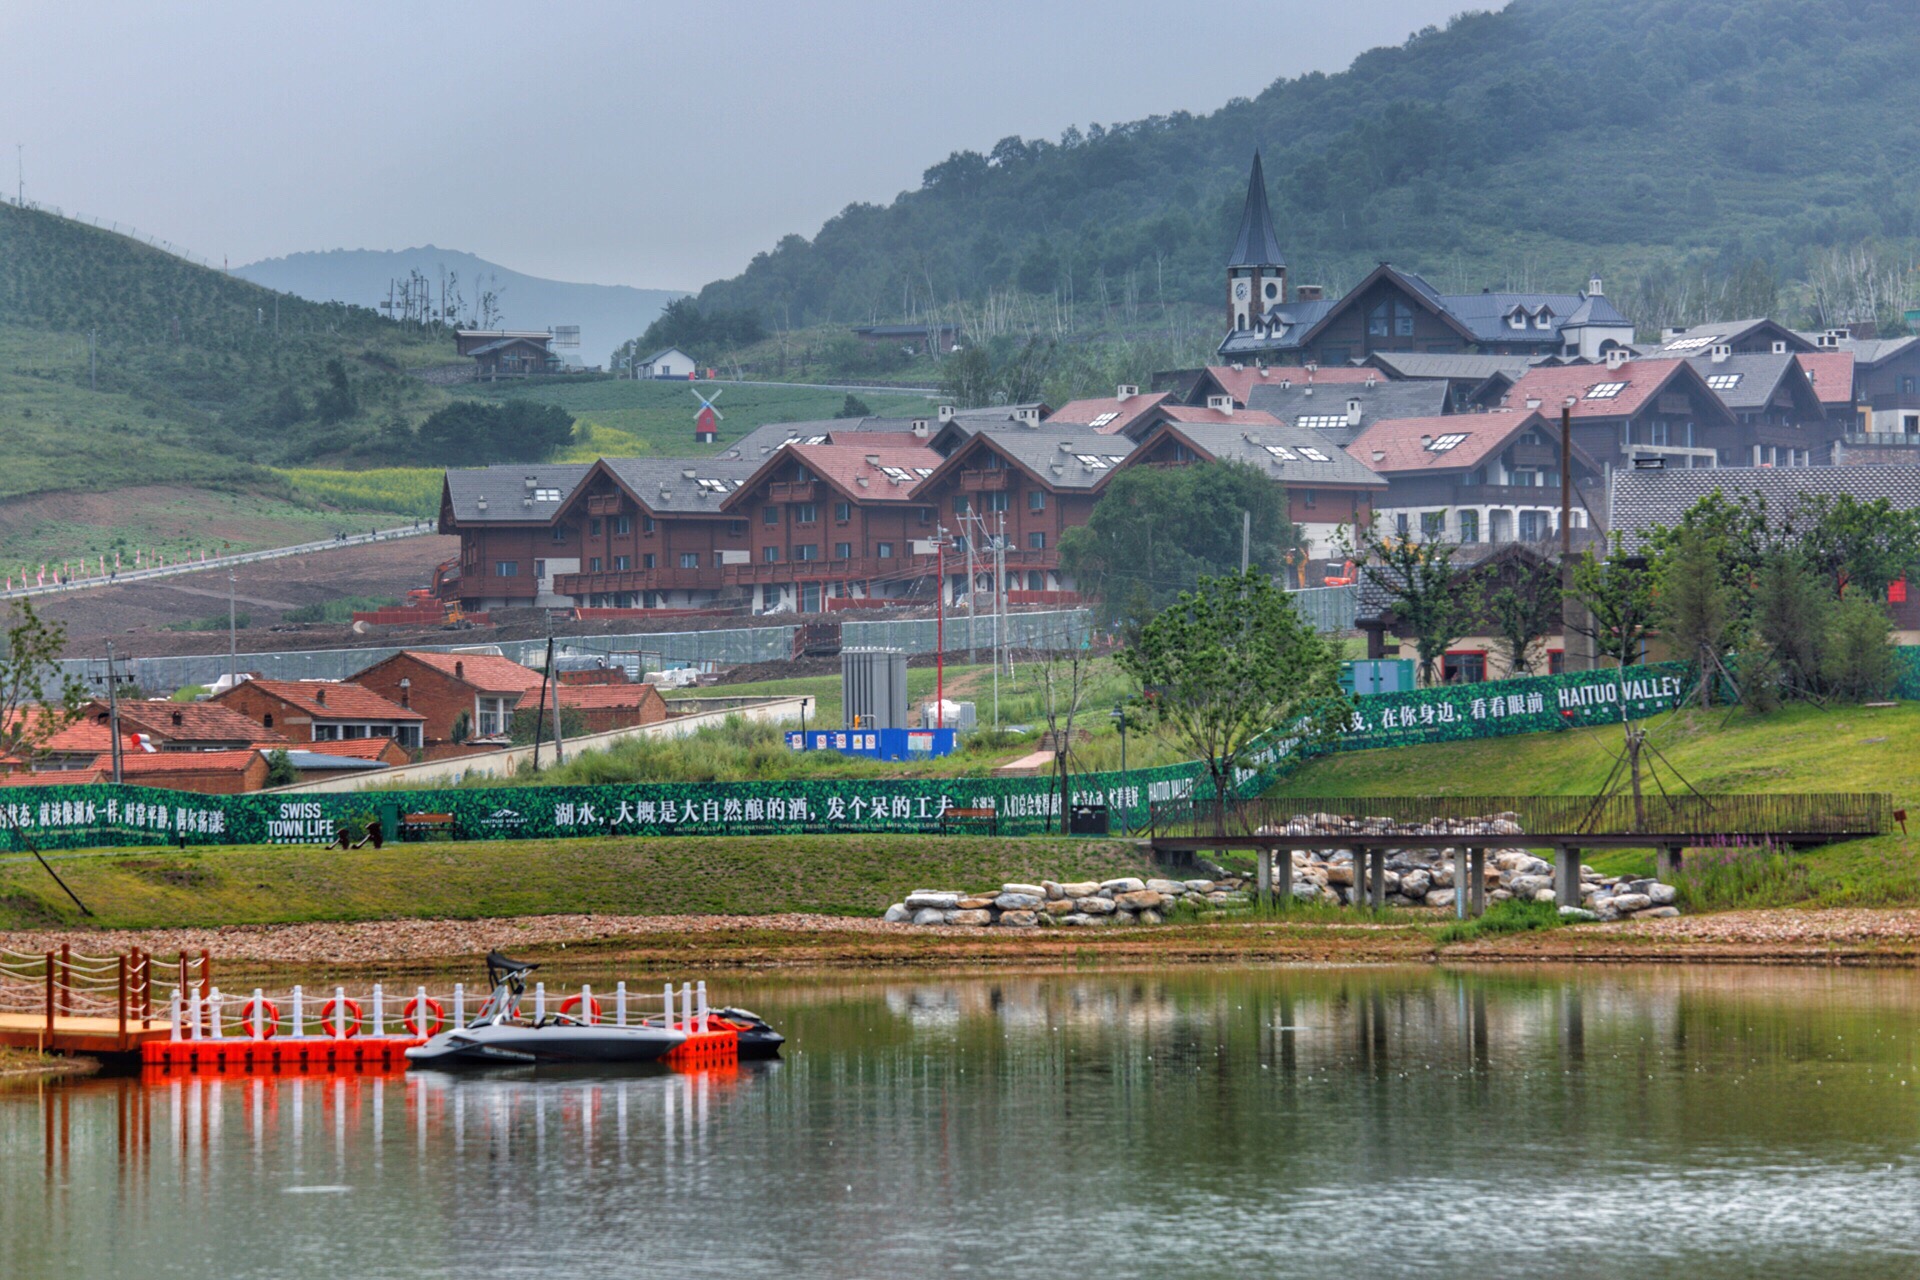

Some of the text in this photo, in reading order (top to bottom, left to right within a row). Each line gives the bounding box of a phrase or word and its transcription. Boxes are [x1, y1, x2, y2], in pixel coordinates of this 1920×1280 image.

[1558, 683, 1617, 708] HAITUO
[1622, 677, 1681, 701] VALLEY
[280, 803, 322, 819] SWISS
[267, 819, 334, 837] TOWN LIFE
